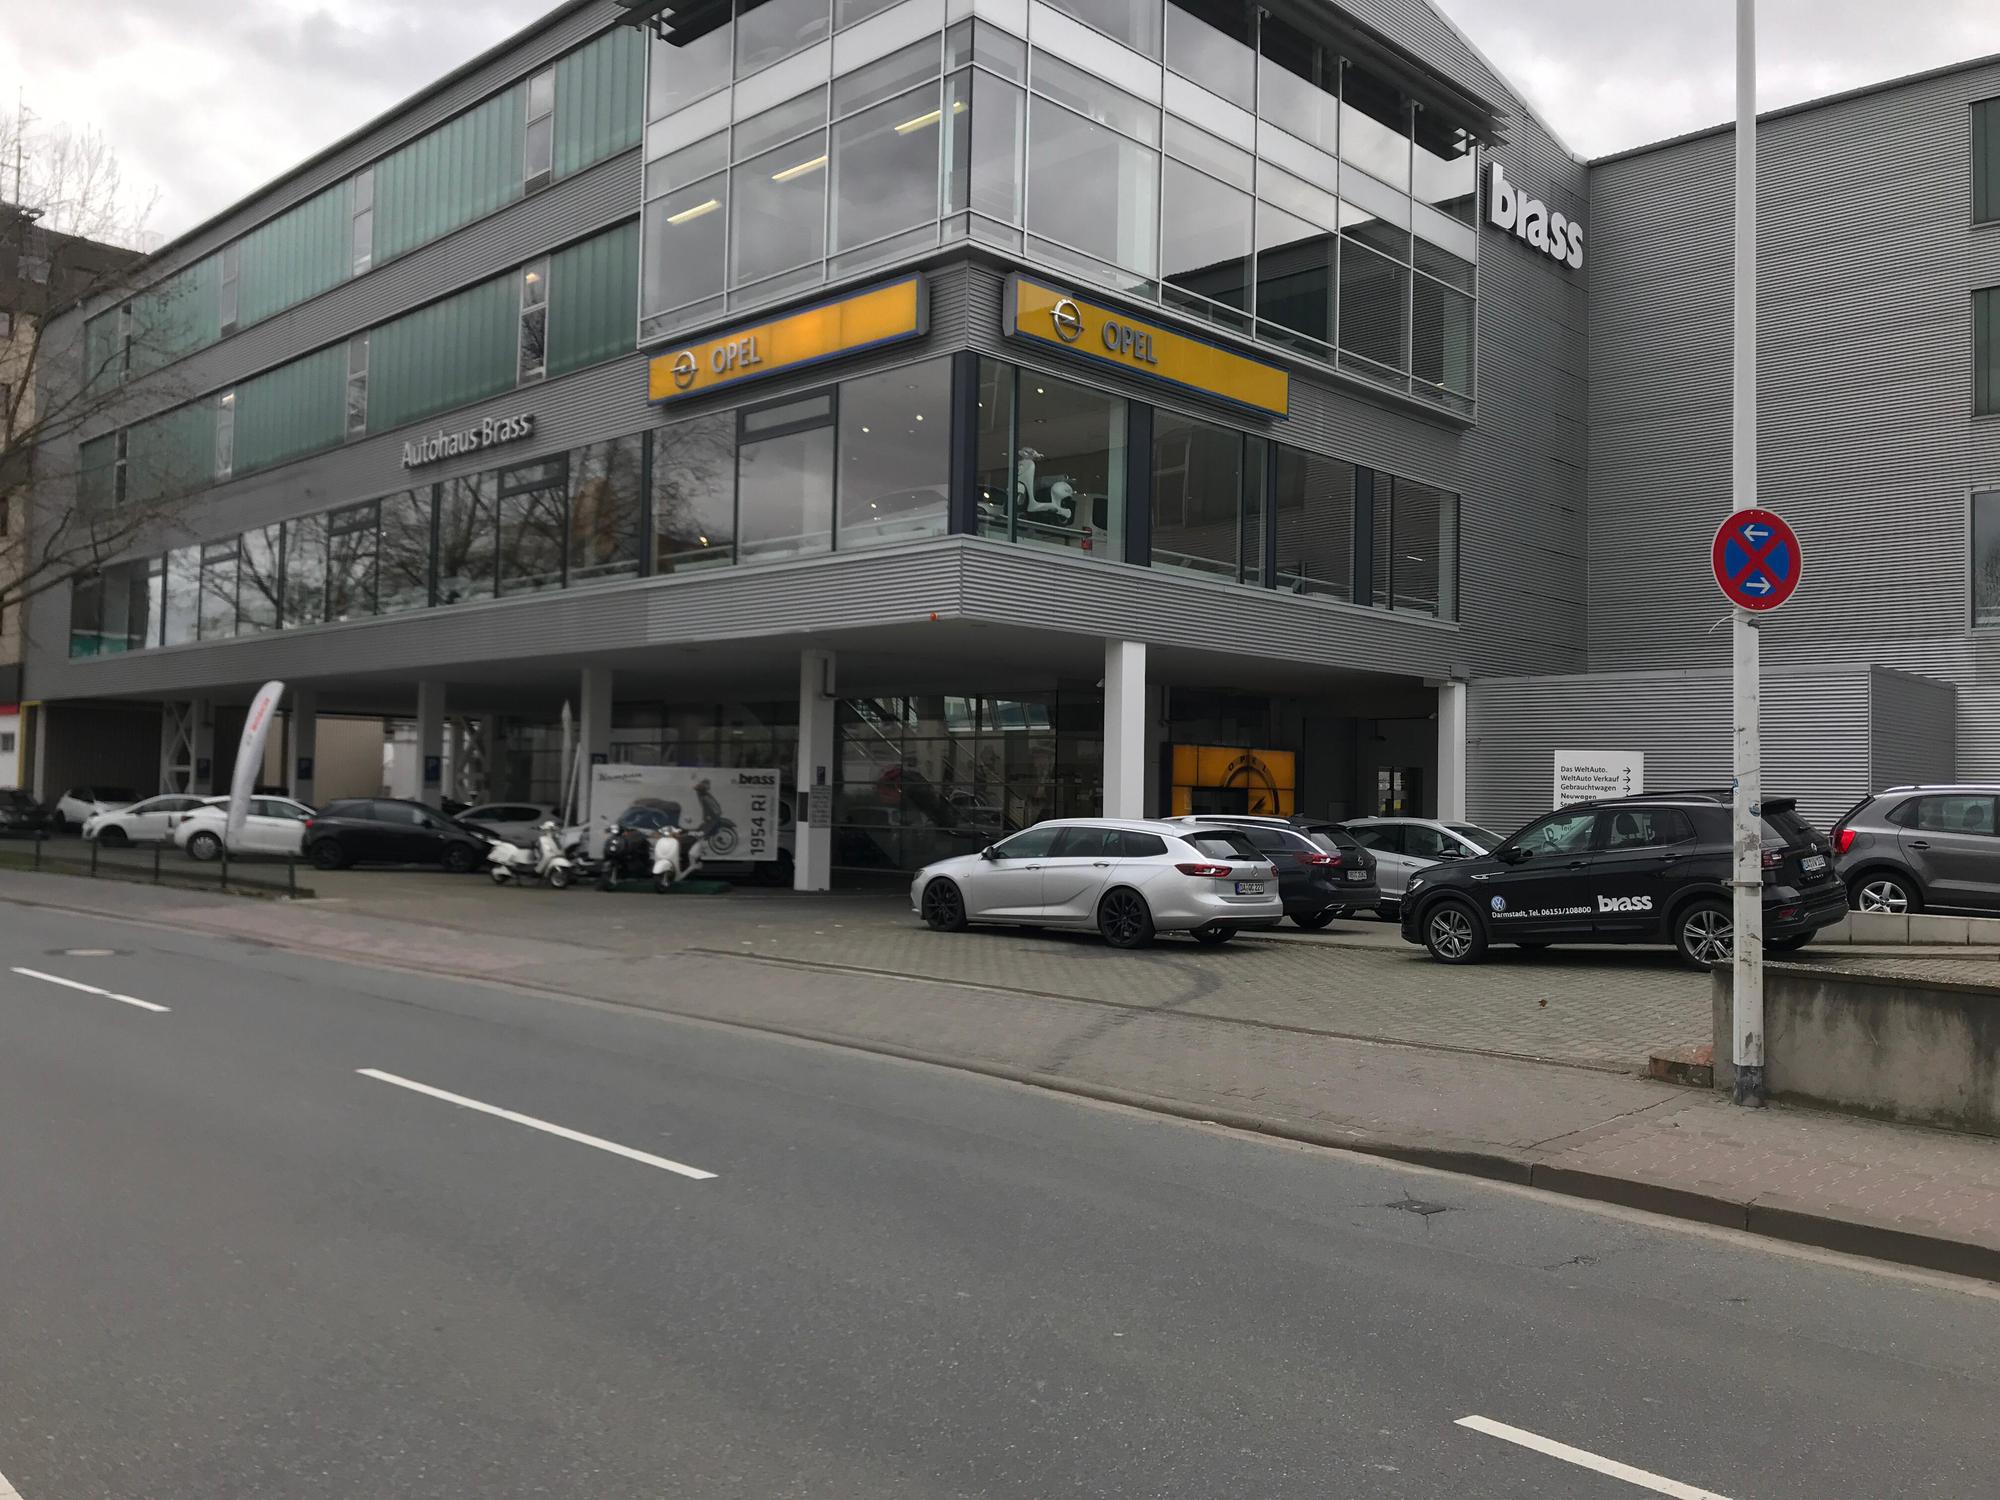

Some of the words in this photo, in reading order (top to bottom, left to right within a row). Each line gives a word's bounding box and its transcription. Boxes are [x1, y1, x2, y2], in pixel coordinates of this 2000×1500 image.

[1488, 162, 1583, 269] brass
[1102, 320, 1156, 363] OPEL
[711, 335, 760, 373] OPEL
[400, 429, 479, 468] Autohaus
[481, 413, 531, 447] Brass
[739, 773, 776, 785] brass
[1560, 784, 1617, 792] Gebrauchtwagen
[1593, 775, 1620, 783] Verkauf
[1560, 793, 1597, 801] Neuwagen
[749, 816, 766, 856] 1954
[1491, 909, 1528, 918] Darmstadt,
[1529, 909, 1541, 917] Tel.
[1541, 906, 1592, 917] 06151/108800
[1597, 894, 1653, 913] brass
